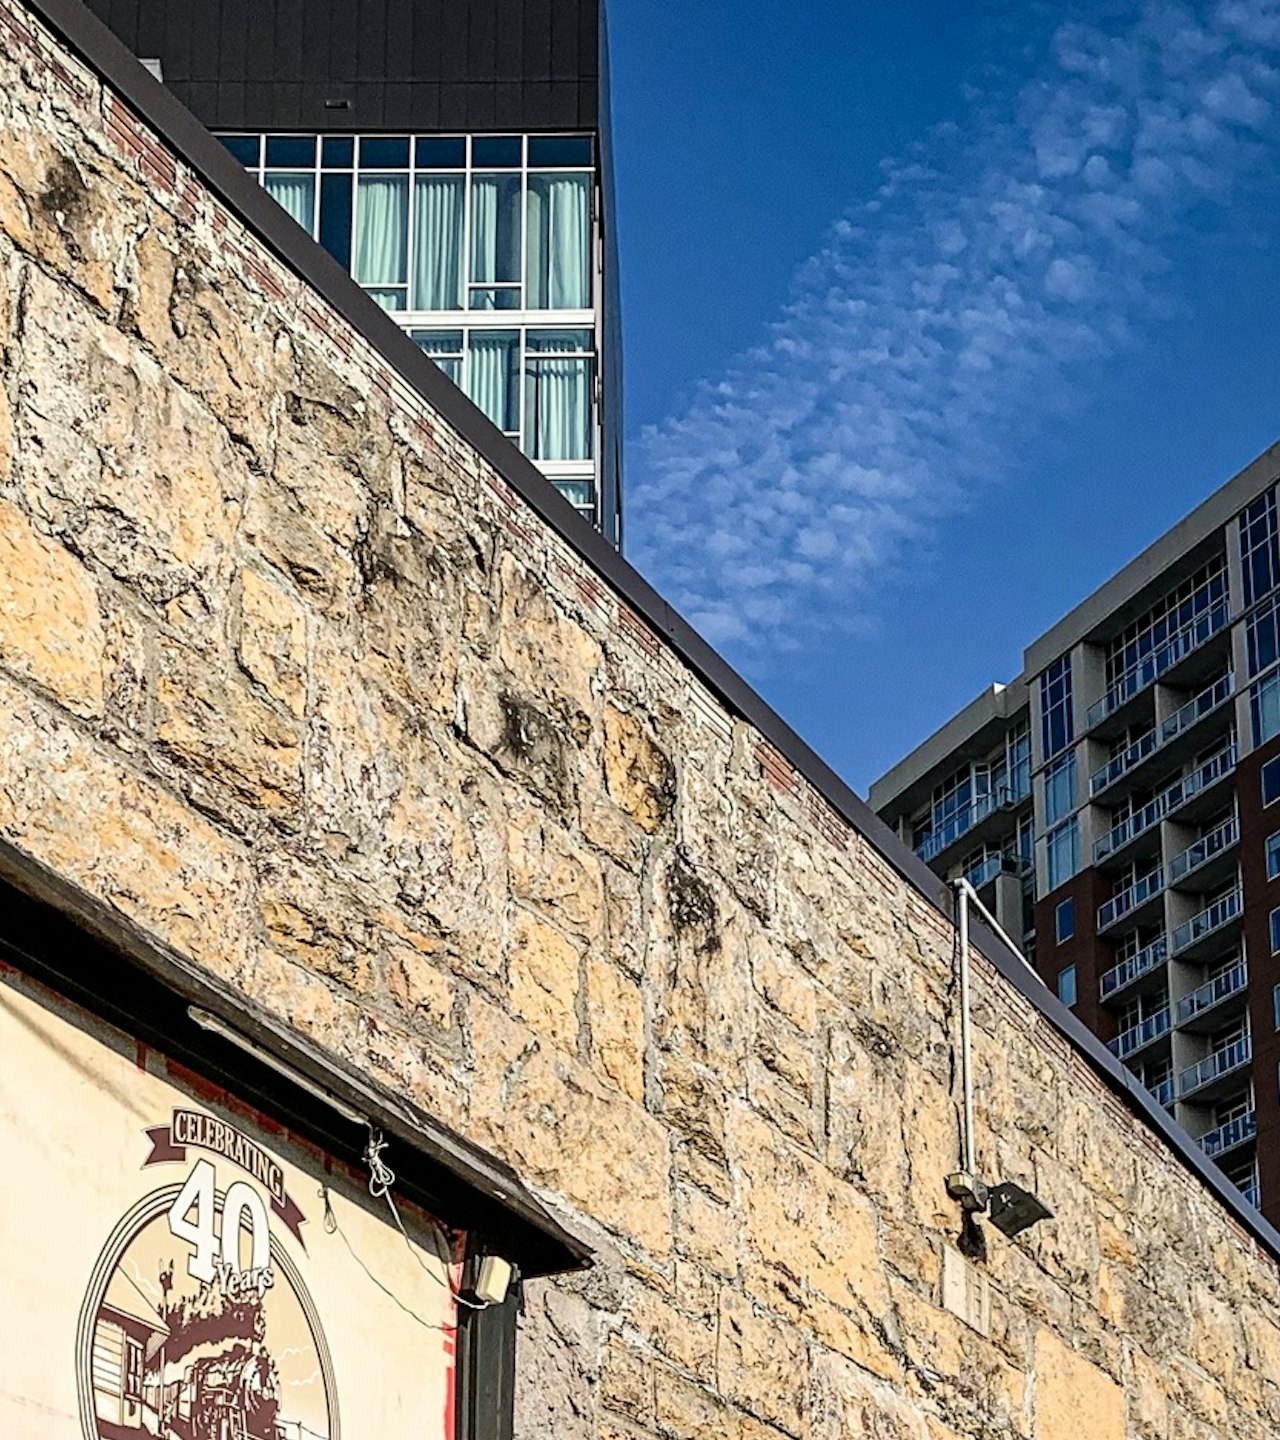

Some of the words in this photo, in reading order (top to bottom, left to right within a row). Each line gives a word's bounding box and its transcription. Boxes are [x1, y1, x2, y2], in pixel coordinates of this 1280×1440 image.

[175, 1112, 283, 1199] CELEBRATING
[167, 1158, 270, 1284] 40
[216, 1262, 275, 1299] Years
